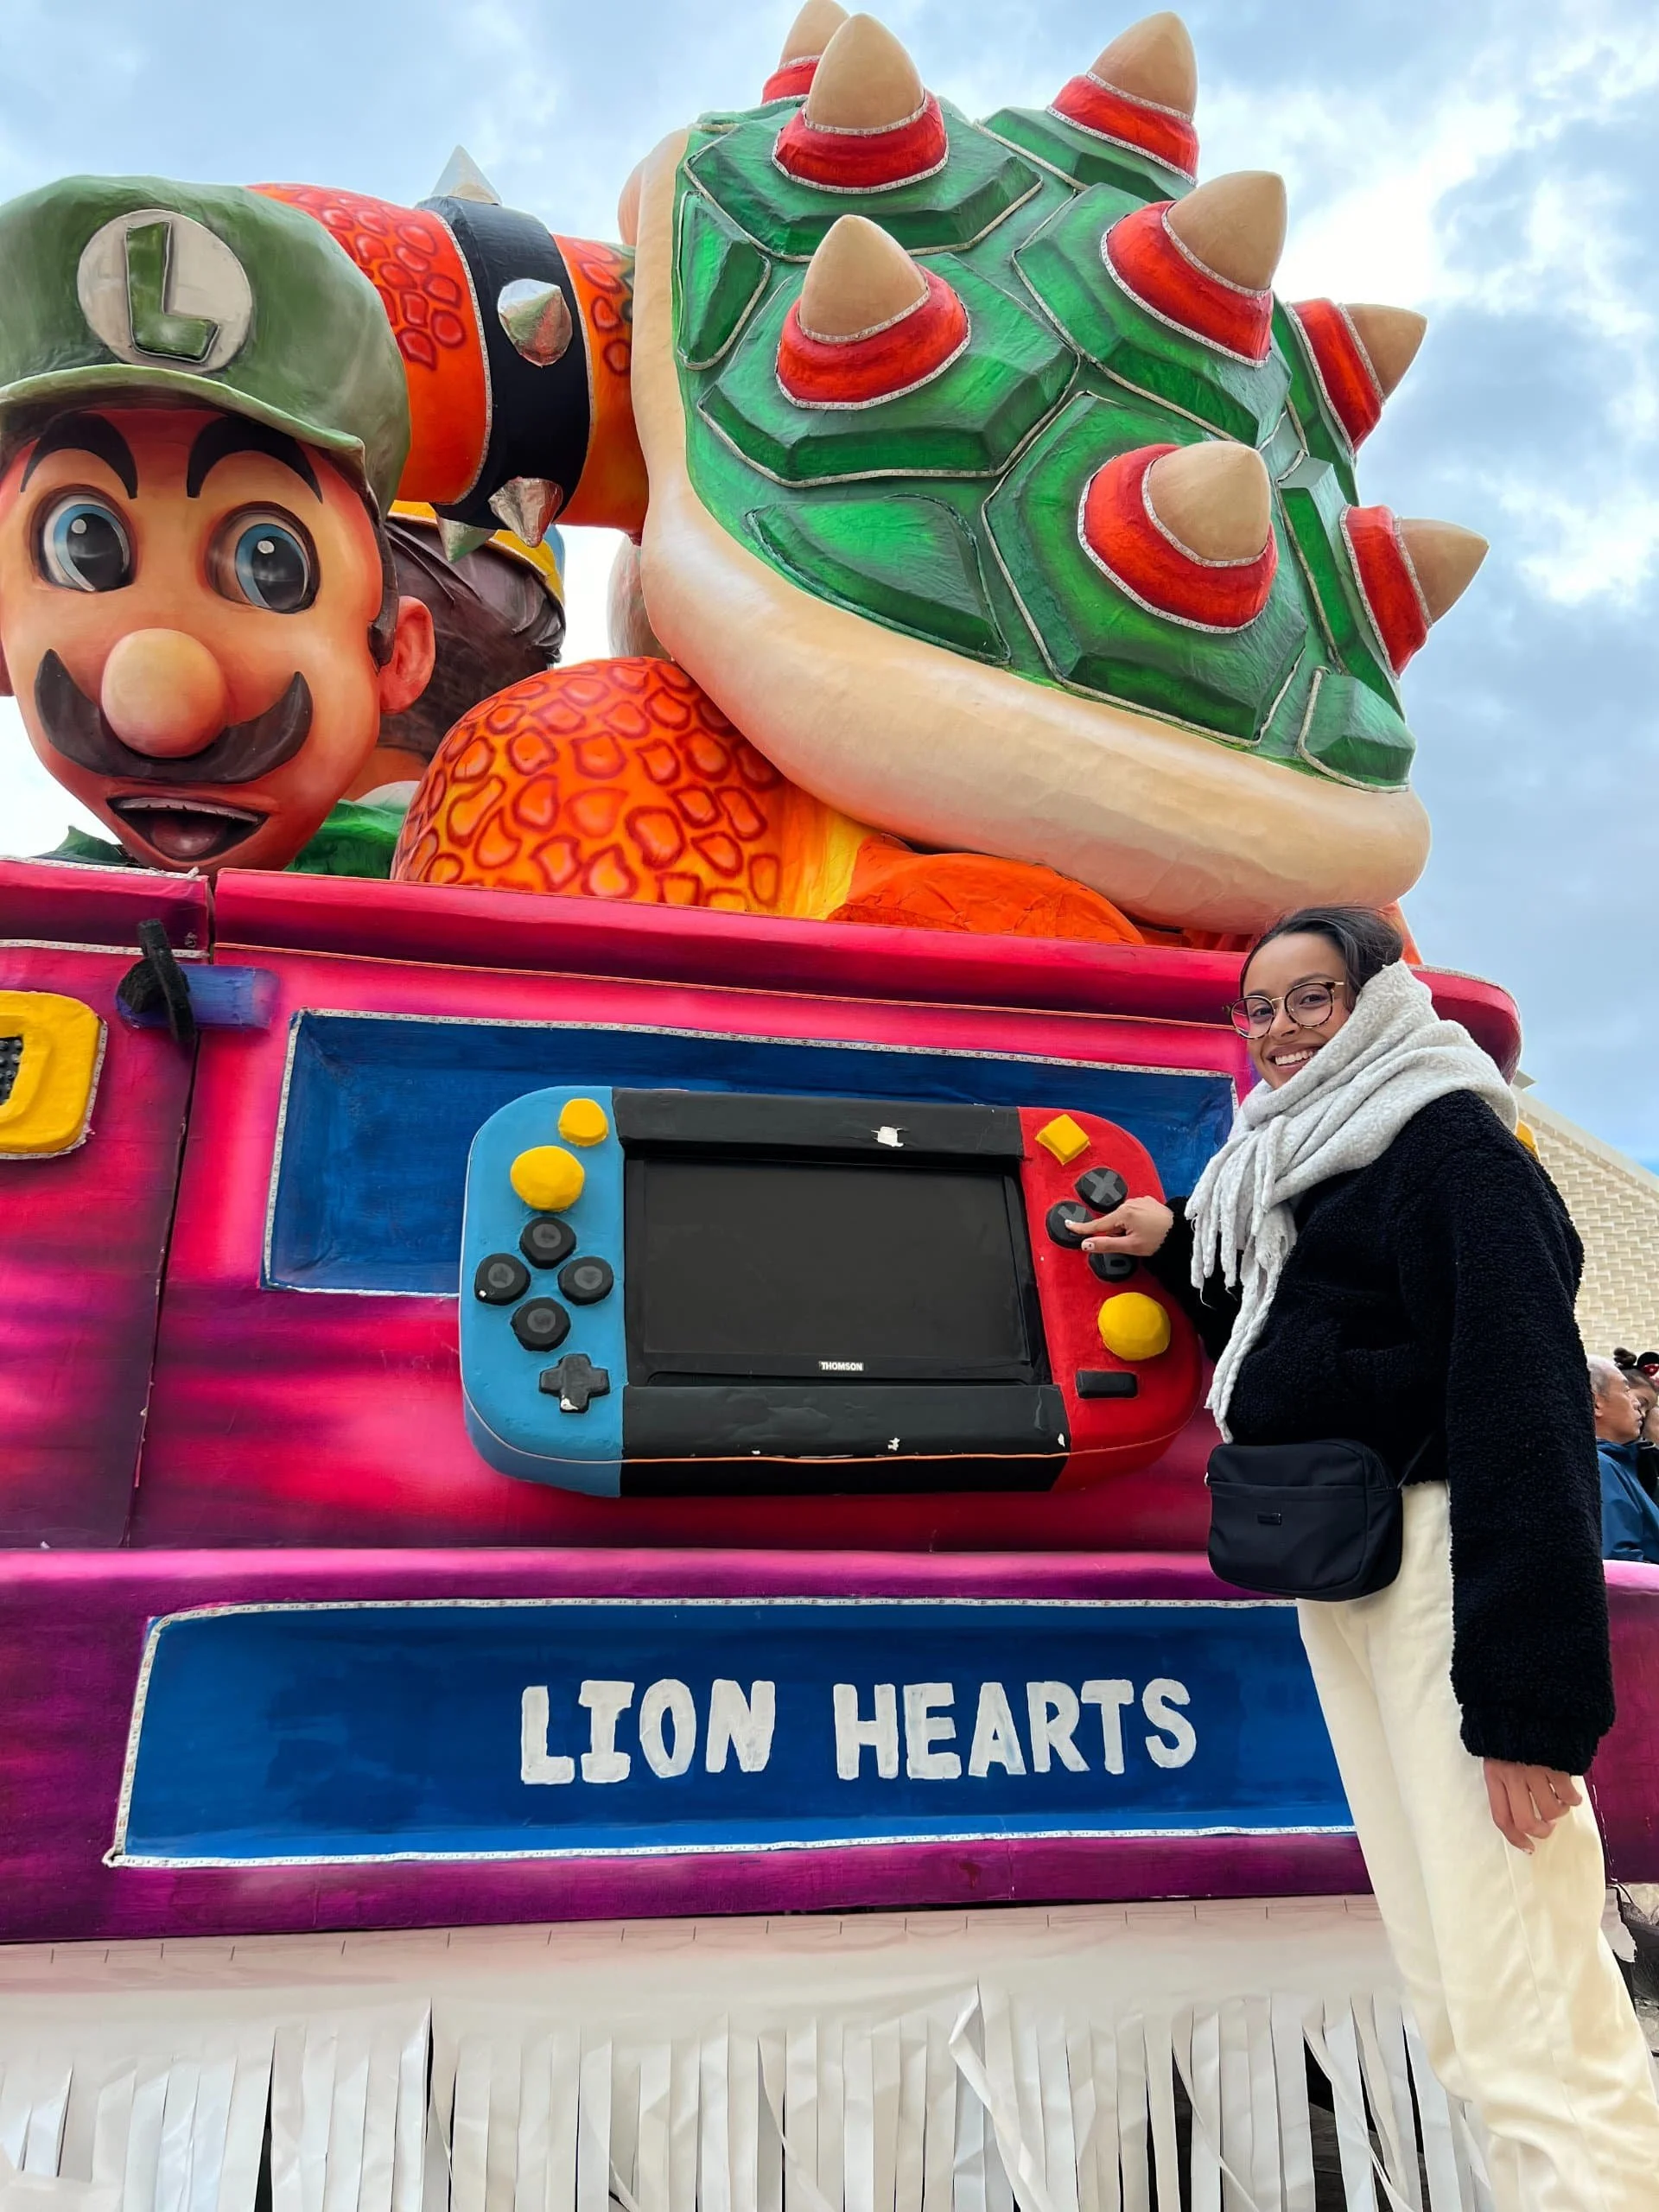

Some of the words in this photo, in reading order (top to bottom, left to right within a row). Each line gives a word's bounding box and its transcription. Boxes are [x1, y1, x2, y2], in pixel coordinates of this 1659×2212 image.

[125, 221, 219, 364] L
[1085, 1170, 1123, 1204] X
[820, 1361, 864, 1371] THOMSON
[521, 1678, 776, 1785] LION
[833, 1678, 1198, 1781] HEARTS
